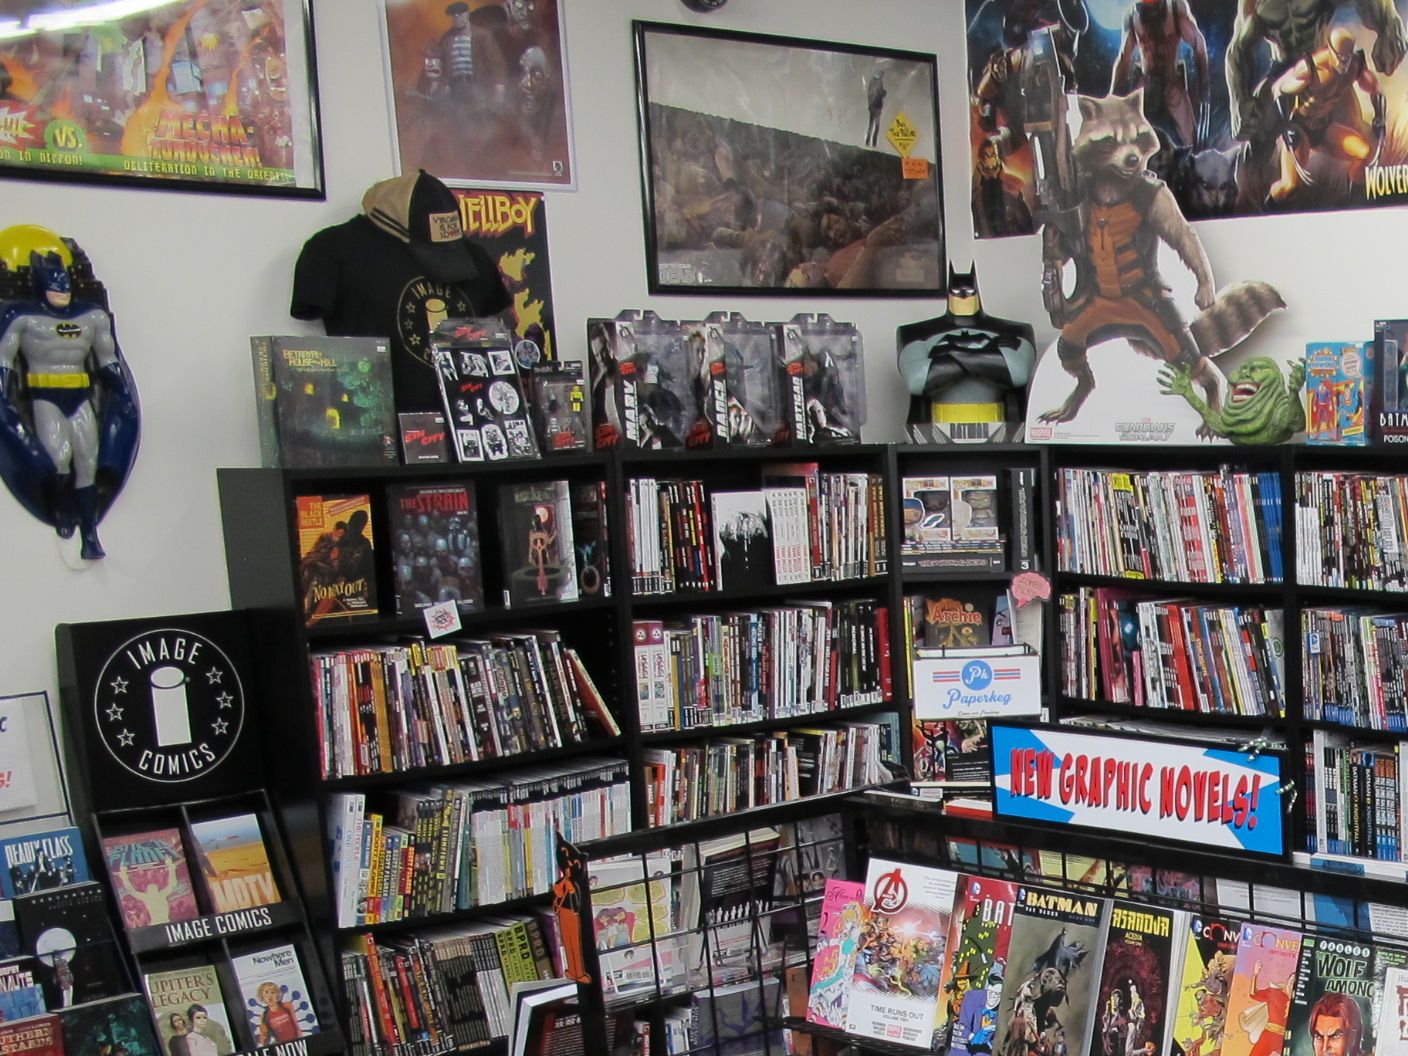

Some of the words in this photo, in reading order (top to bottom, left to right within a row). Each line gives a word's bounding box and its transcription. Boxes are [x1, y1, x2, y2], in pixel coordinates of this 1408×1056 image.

[54, 128, 83, 148] VS.
[123, 160, 198, 175] OBLITERATION
[624, 380, 640, 441] MARV
[1383, 434, 1408, 443] POISON
[416, 491, 469, 513] STRAIN
[1020, 561, 1030, 570] 3
[932, 602, 983, 626] Archie
[127, 638, 202, 670] IMAGE
[942, 687, 1013, 710] Paperkeg
[139, 743, 216, 775] COMICS
[1010, 747, 1055, 799] NEW
[1059, 752, 1154, 814] GRAPHIC
[1159, 764, 1263, 832] NOVELS!
[1026, 891, 1099, 918] BATMAN
[165, 917, 213, 943] IMAGE
[216, 907, 272, 934] COMICS
[252, 950, 292, 966] Nowhere
[1319, 940, 1370, 958] FABLES
[273, 957, 294, 969] Men
[1317, 954, 1367, 979] WOLF
[870, 1004, 891, 1014] TIME
[892, 1007, 911, 1018] RUNS
[911, 1010, 924, 1022] OUT
